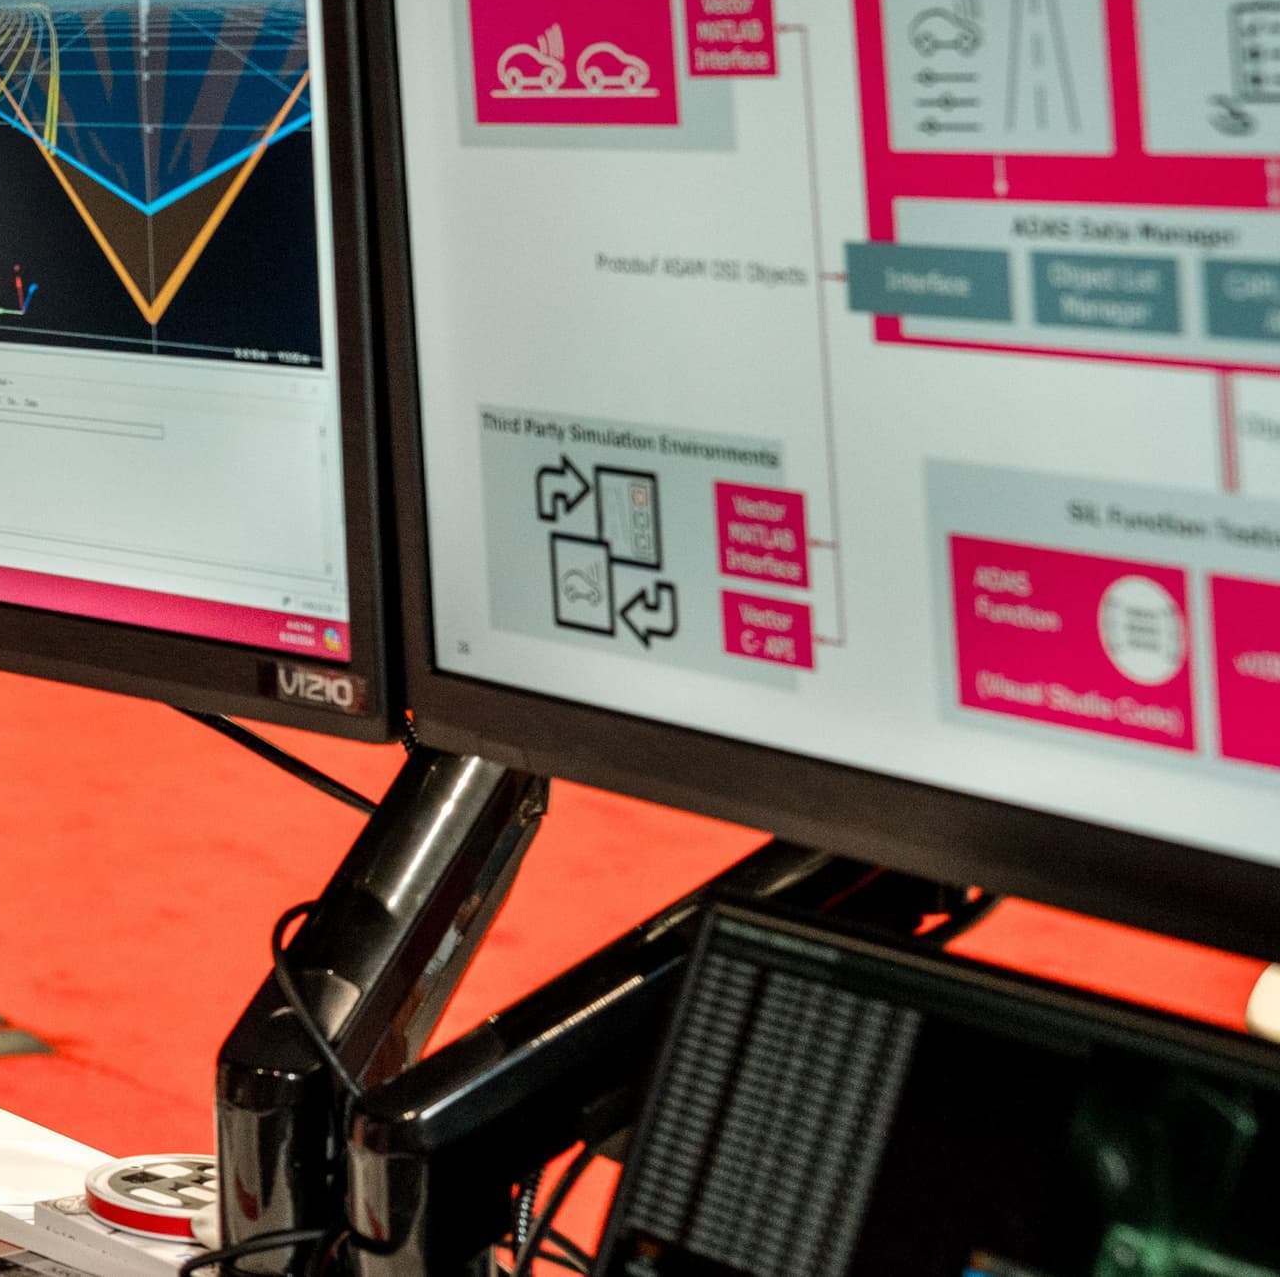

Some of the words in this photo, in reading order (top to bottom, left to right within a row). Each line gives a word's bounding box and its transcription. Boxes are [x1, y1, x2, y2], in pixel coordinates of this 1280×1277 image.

[482, 412, 523, 435] Third
[524, 418, 565, 443] Party
[570, 425, 655, 453] Simulation
[659, 435, 780, 468] Environments
[732, 495, 787, 521] Vector
[726, 548, 802, 581] Interface
[278, 666, 354, 709] VIZIO
